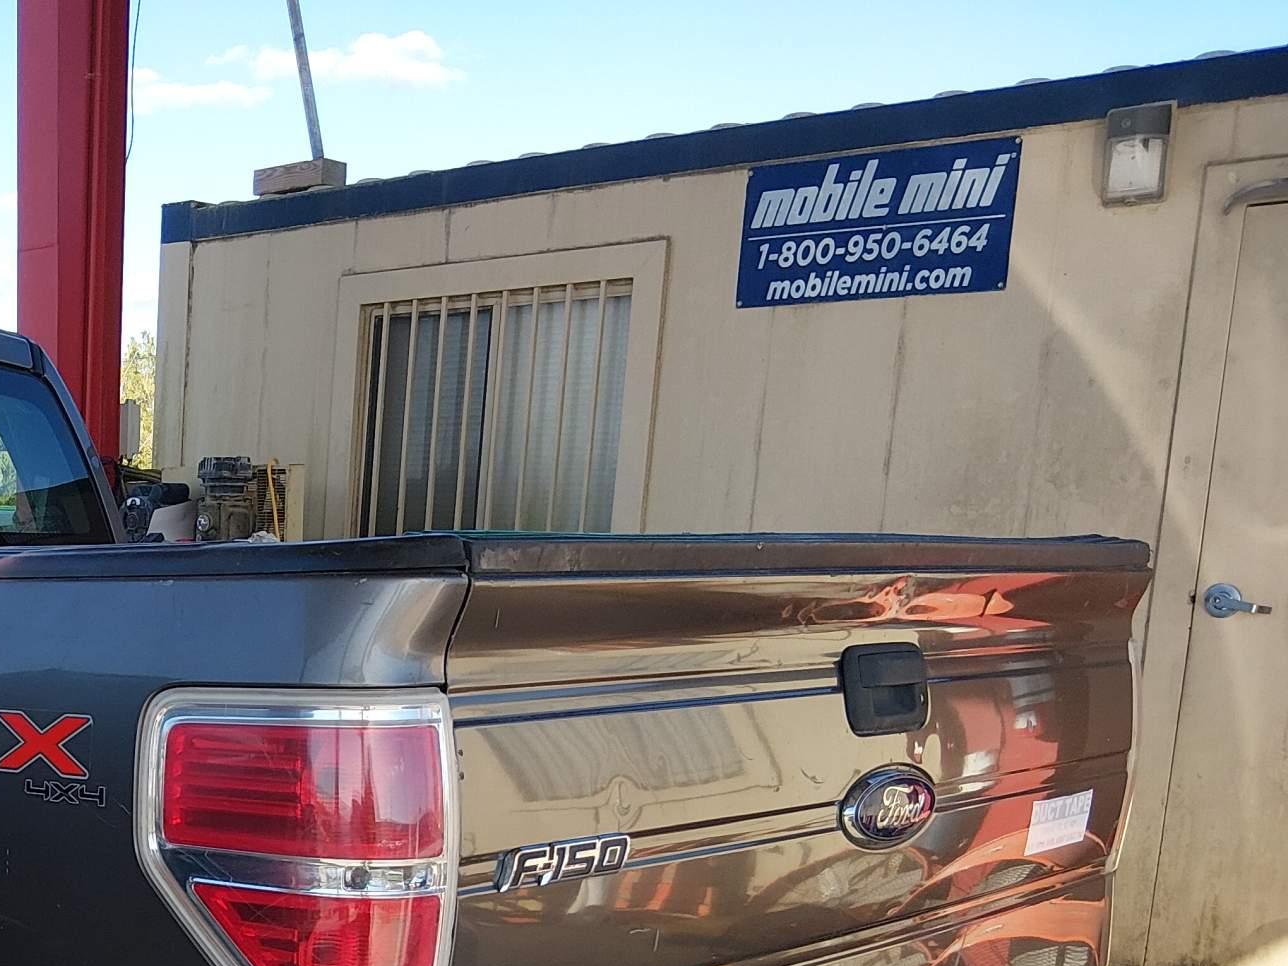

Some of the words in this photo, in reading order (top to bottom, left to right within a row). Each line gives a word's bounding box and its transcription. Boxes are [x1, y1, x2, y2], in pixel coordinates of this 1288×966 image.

[750, 159, 898, 229] mobile
[897, 153, 1011, 215] mini
[757, 223, 990, 270] 1-800-950-6464
[766, 265, 972, 301] mobilemini.com
[877, 784, 931, 830] Ford
